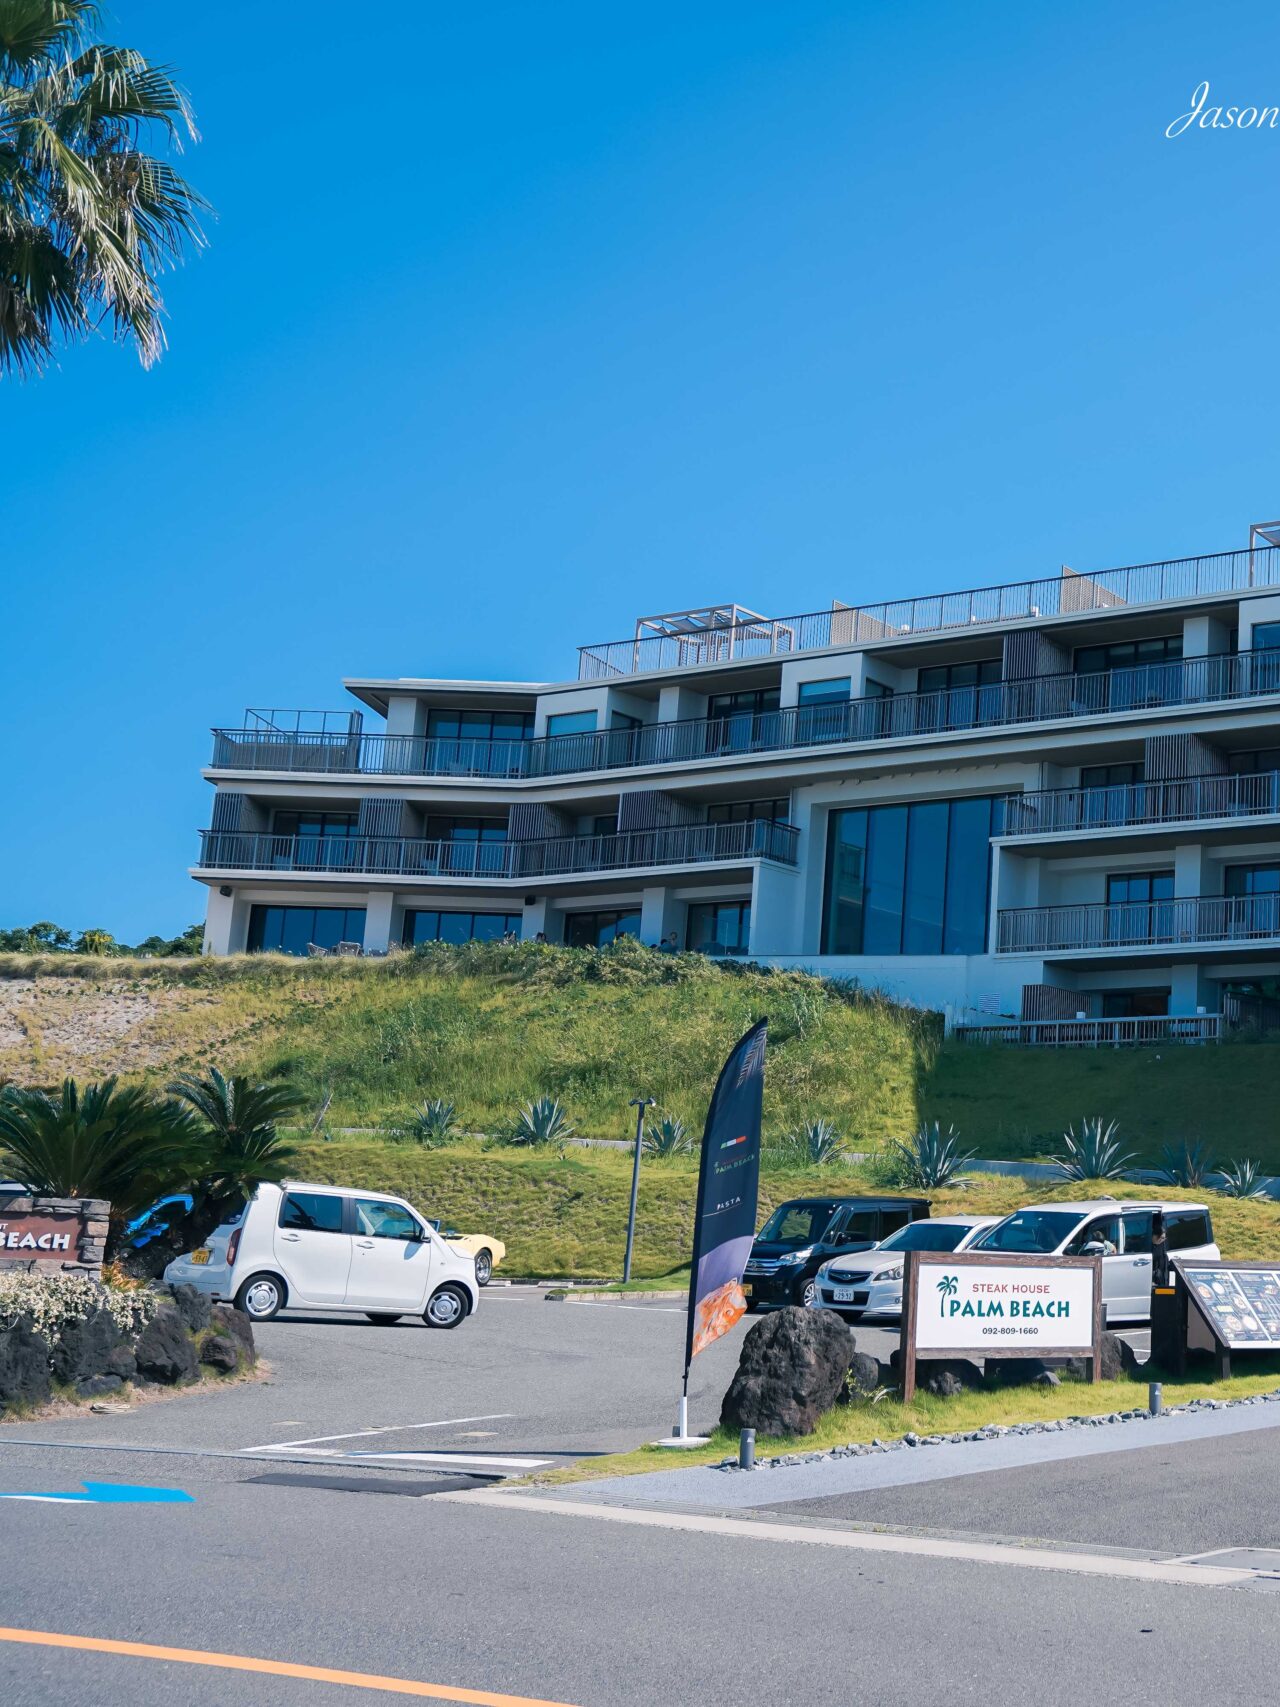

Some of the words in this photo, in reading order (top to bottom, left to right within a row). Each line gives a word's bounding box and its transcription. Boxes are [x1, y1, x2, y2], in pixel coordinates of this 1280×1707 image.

[716, 1196, 741, 1211] PASTA
[972, 1283, 1009, 1294] STEAK
[1012, 1284, 1051, 1294] HOUSE
[949, 1299, 1005, 1318] PALM
[1010, 1300, 1070, 1318] BEACH
[982, 1327, 1039, 1335] 092-809-1660
